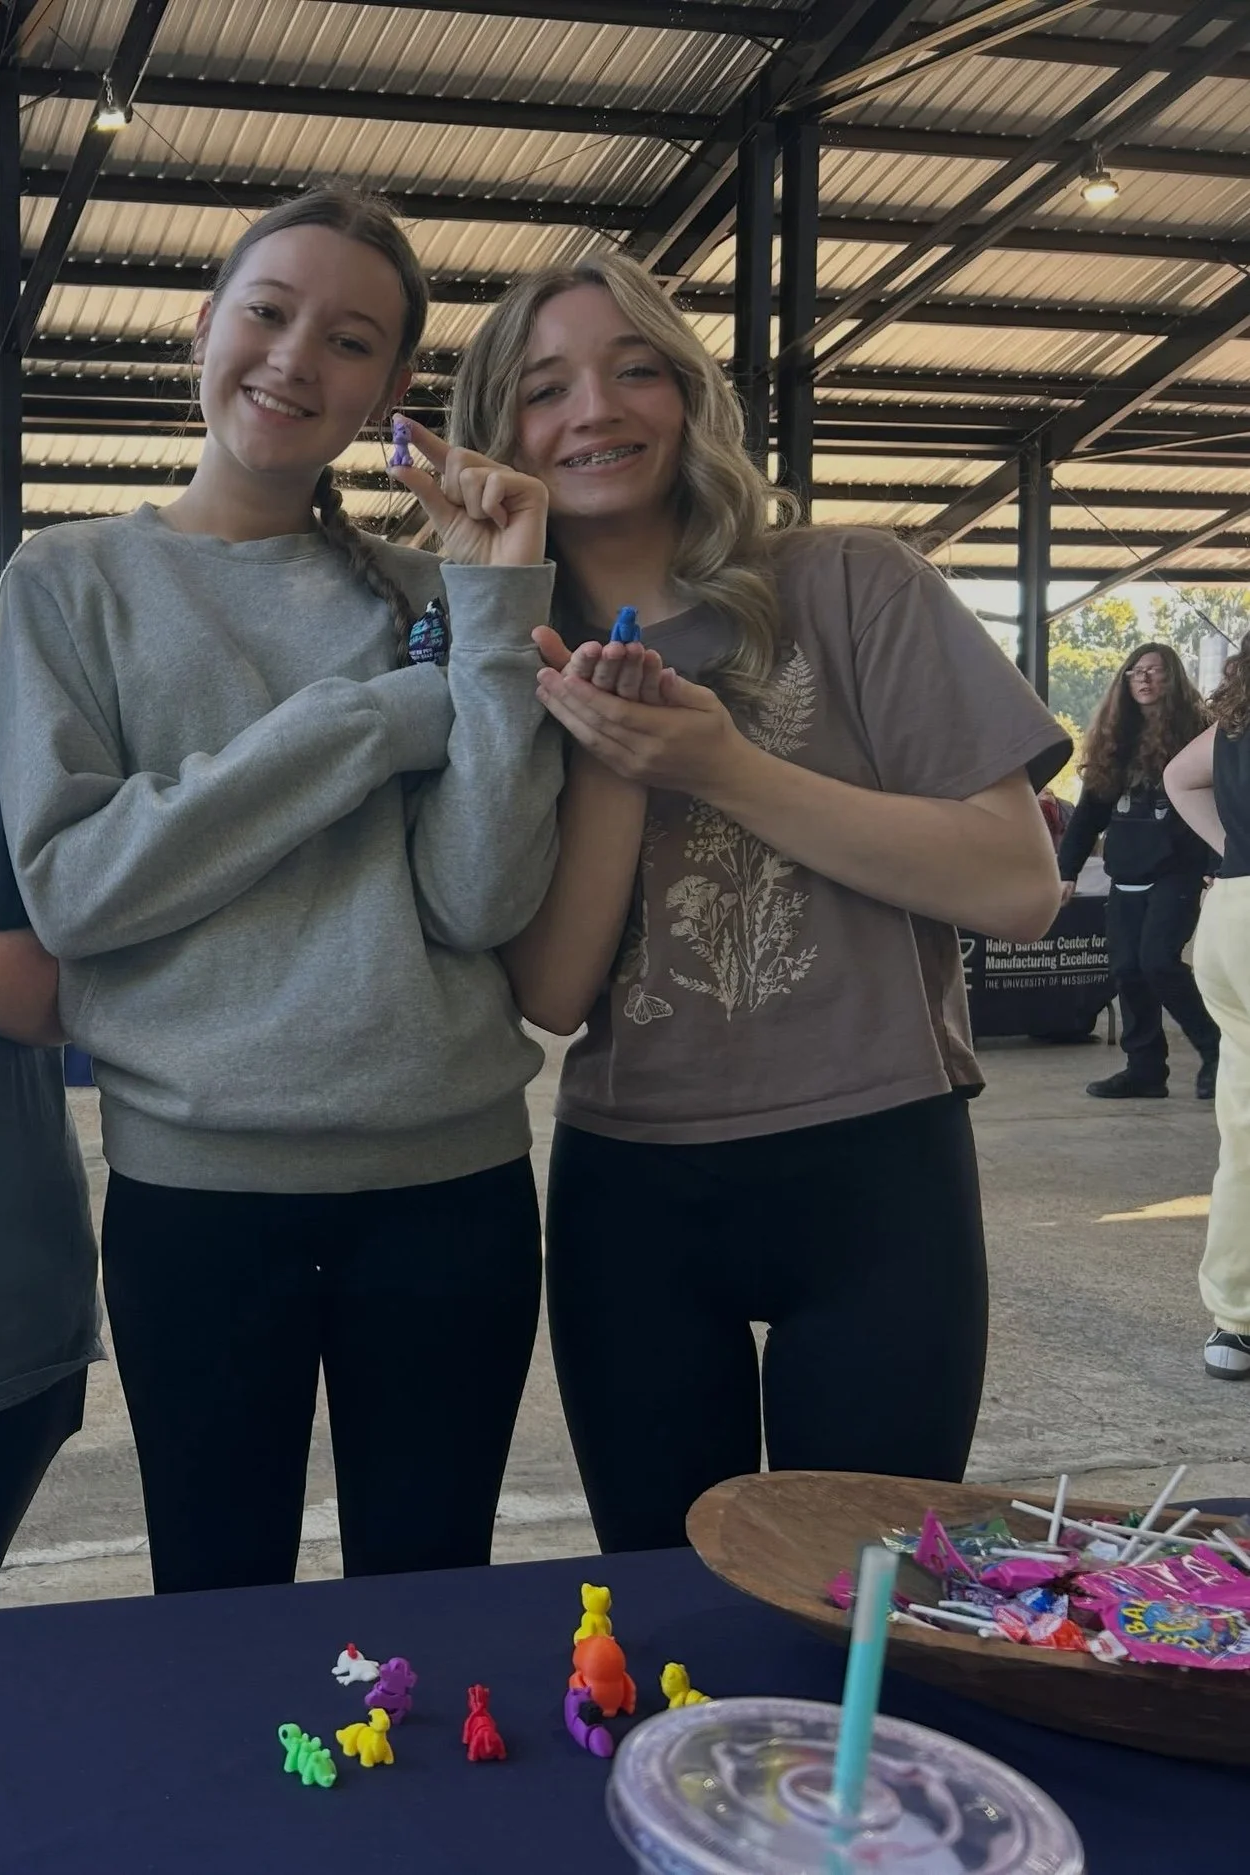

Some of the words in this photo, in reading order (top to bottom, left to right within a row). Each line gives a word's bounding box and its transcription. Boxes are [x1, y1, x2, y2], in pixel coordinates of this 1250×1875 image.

[986, 938, 1012, 955] Haley
[1057, 936, 1089, 951] Center
[1091, 934, 1107, 948] for
[985, 954, 1056, 970] Manufacturing
[1060, 952, 1109, 967] Excellence
[985, 978, 999, 989] THE
[1002, 977, 1046, 989] UNIVERSITY
[1049, 976, 1059, 986] OF
